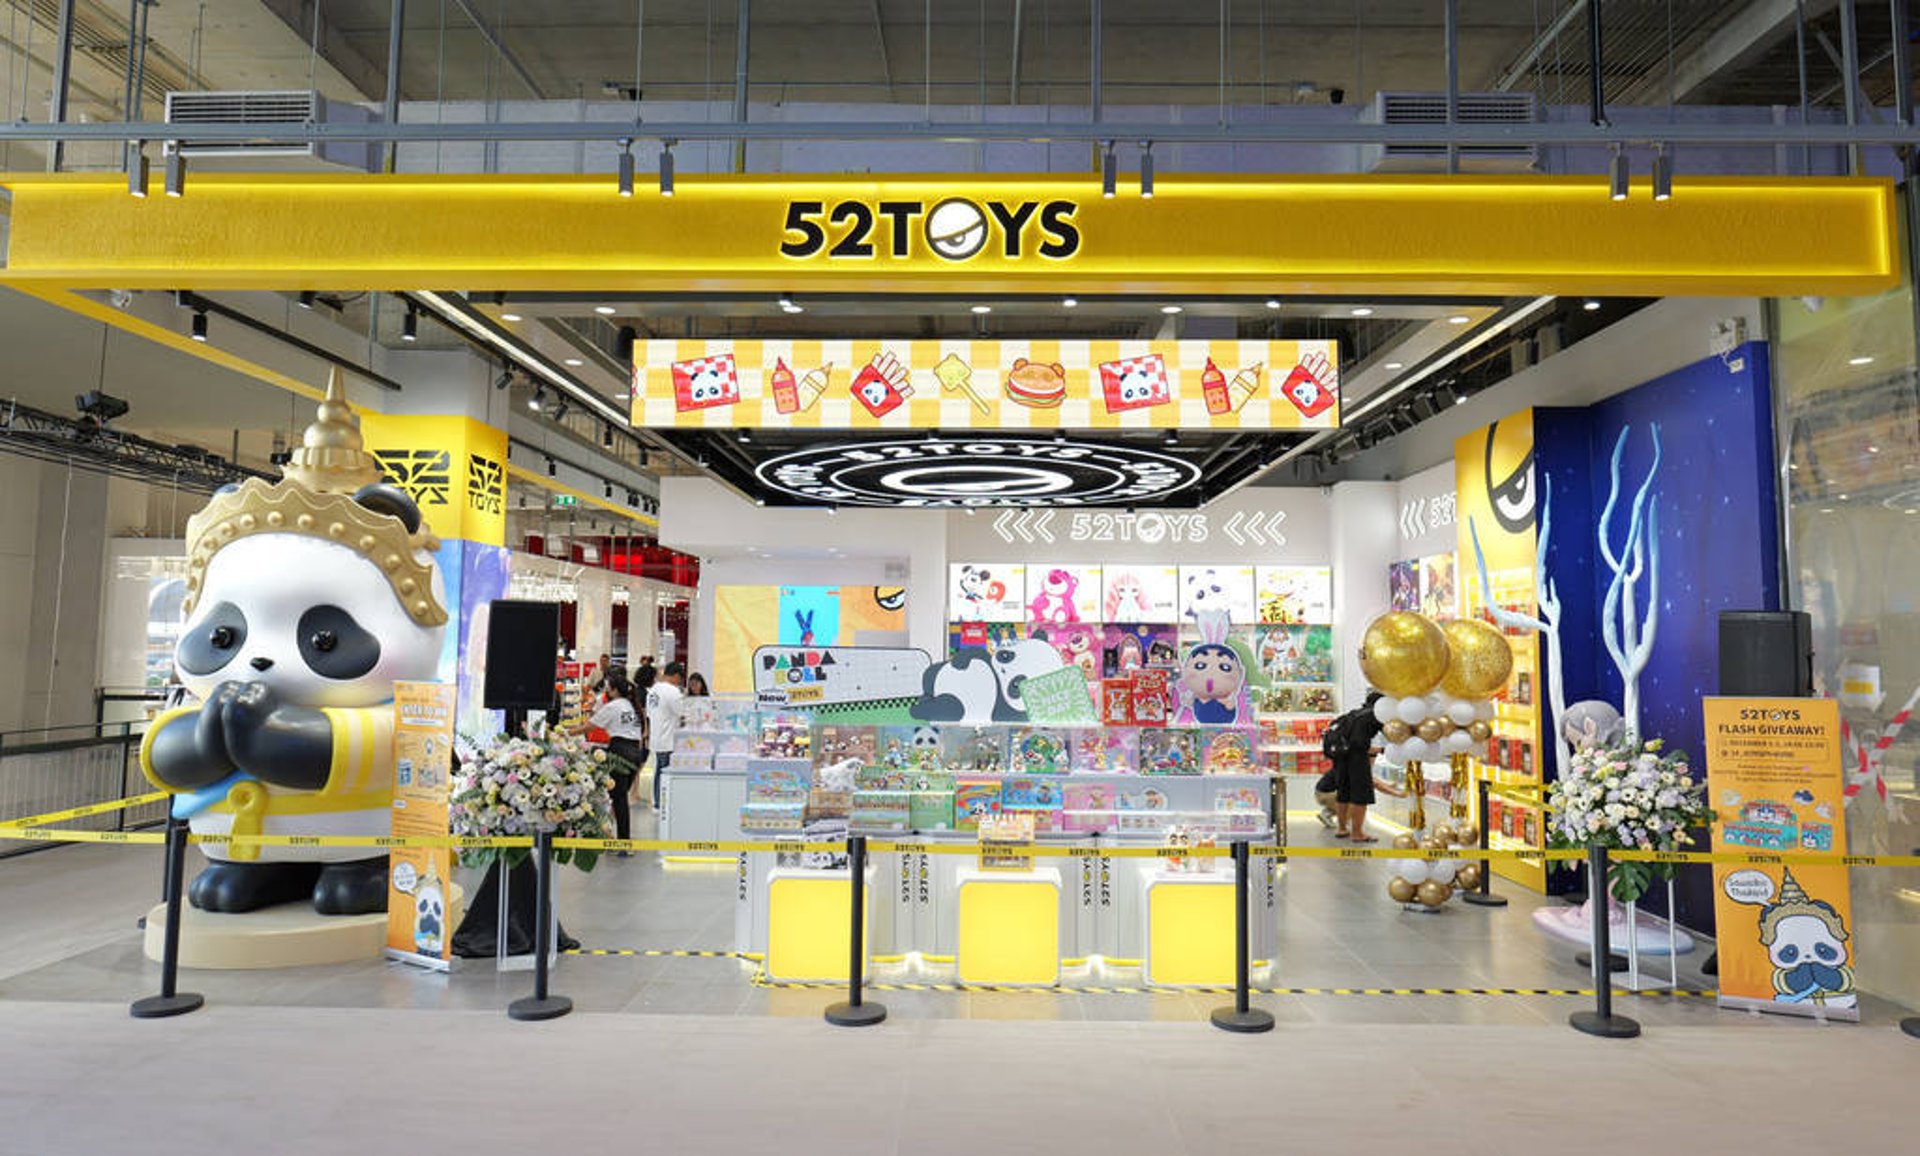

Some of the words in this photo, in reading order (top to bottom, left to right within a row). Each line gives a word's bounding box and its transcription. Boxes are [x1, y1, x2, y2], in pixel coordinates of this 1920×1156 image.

[781, 197, 1080, 260] 52TOYS
[841, 442, 1093, 460] 52TOYS
[468, 454, 503, 495] 52
[468, 490, 501, 515] TOYS
[1070, 512, 1209, 543] 52TOYS
[763, 650, 836, 670] PANDA
[1740, 709, 1801, 721] 52TOYS
[1718, 724, 1756, 734] FLASH
[1758, 725, 1826, 736] GIVEAWAY!
